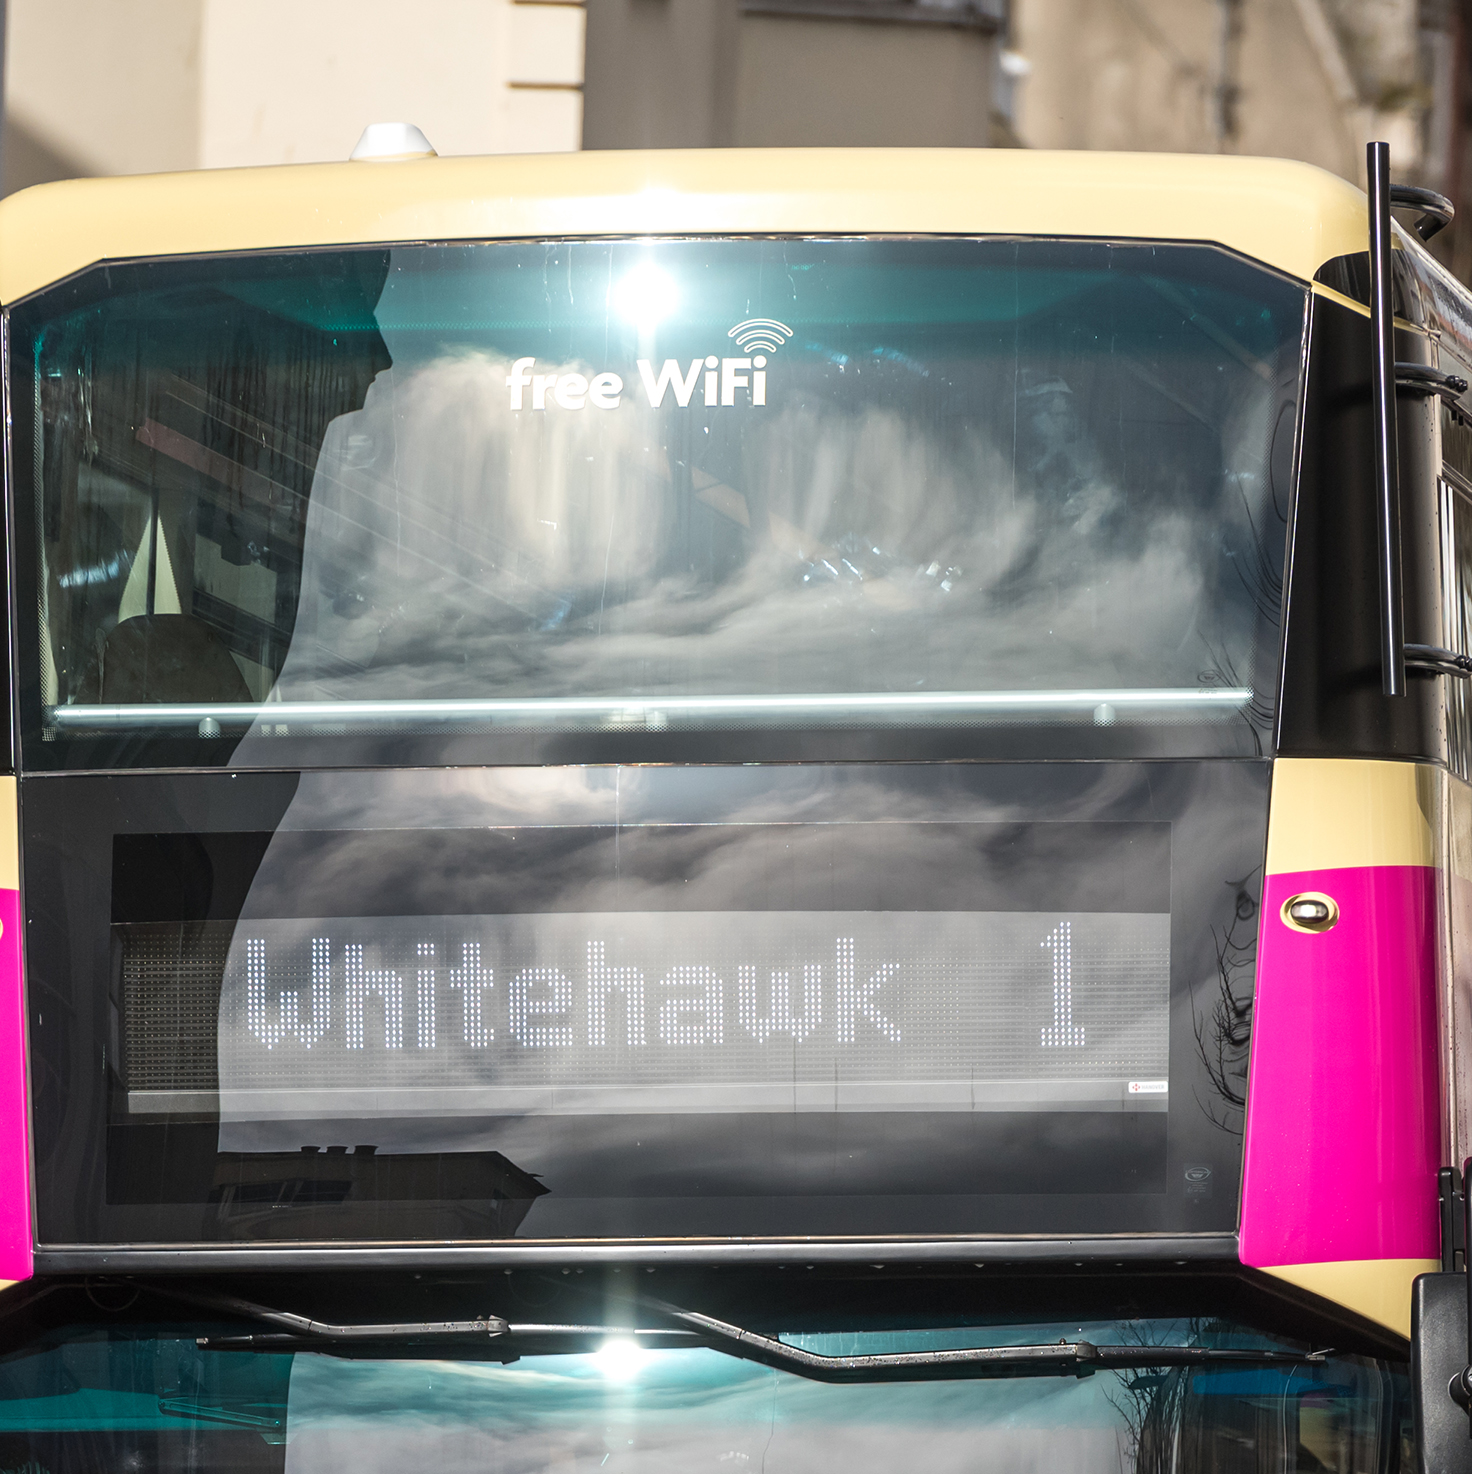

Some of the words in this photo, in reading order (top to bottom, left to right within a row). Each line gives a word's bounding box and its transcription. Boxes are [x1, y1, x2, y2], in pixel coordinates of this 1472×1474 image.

[505, 356, 624, 411] free
[636, 355, 768, 409] WiFi
[247, 937, 901, 1049] Whitehawk
[1040, 921, 1086, 1047] 1
